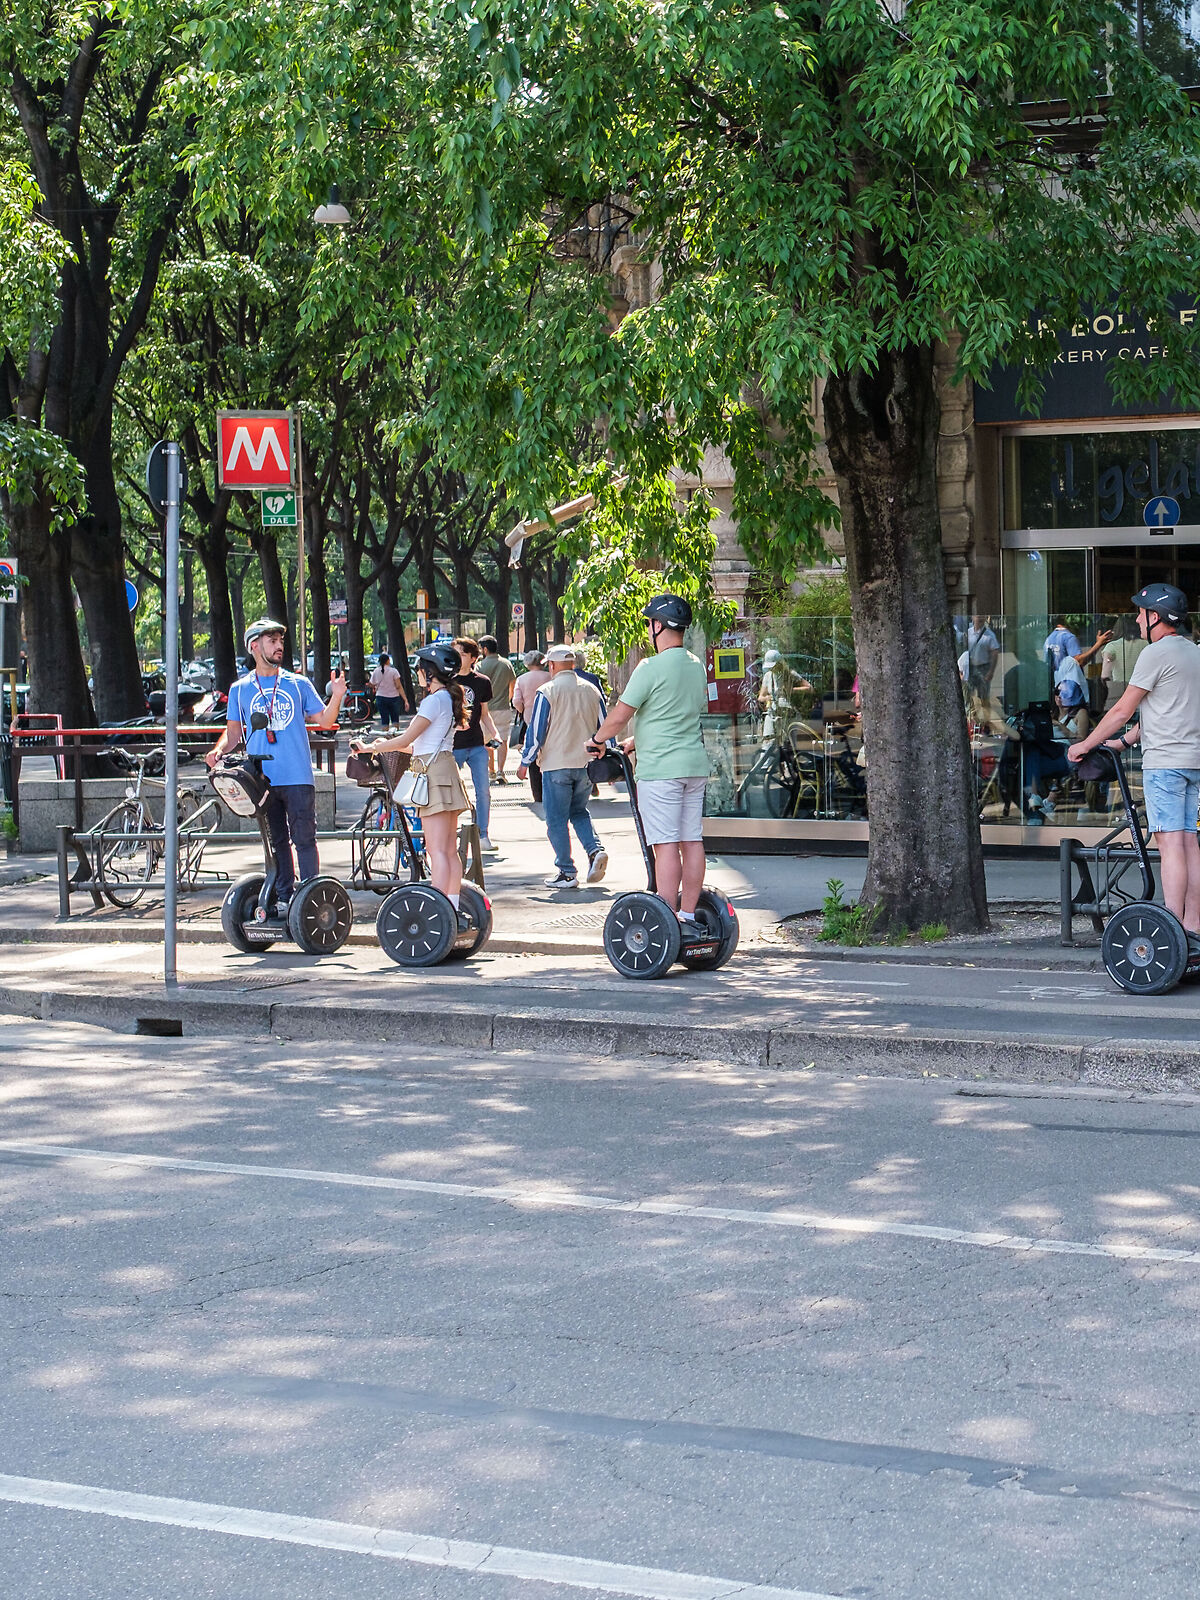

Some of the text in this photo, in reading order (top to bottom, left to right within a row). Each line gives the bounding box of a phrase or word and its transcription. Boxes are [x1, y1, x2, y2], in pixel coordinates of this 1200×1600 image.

[1024, 348, 1108, 365] KERY
[225, 426, 289, 471] M
[1051, 442, 1080, 500] il
